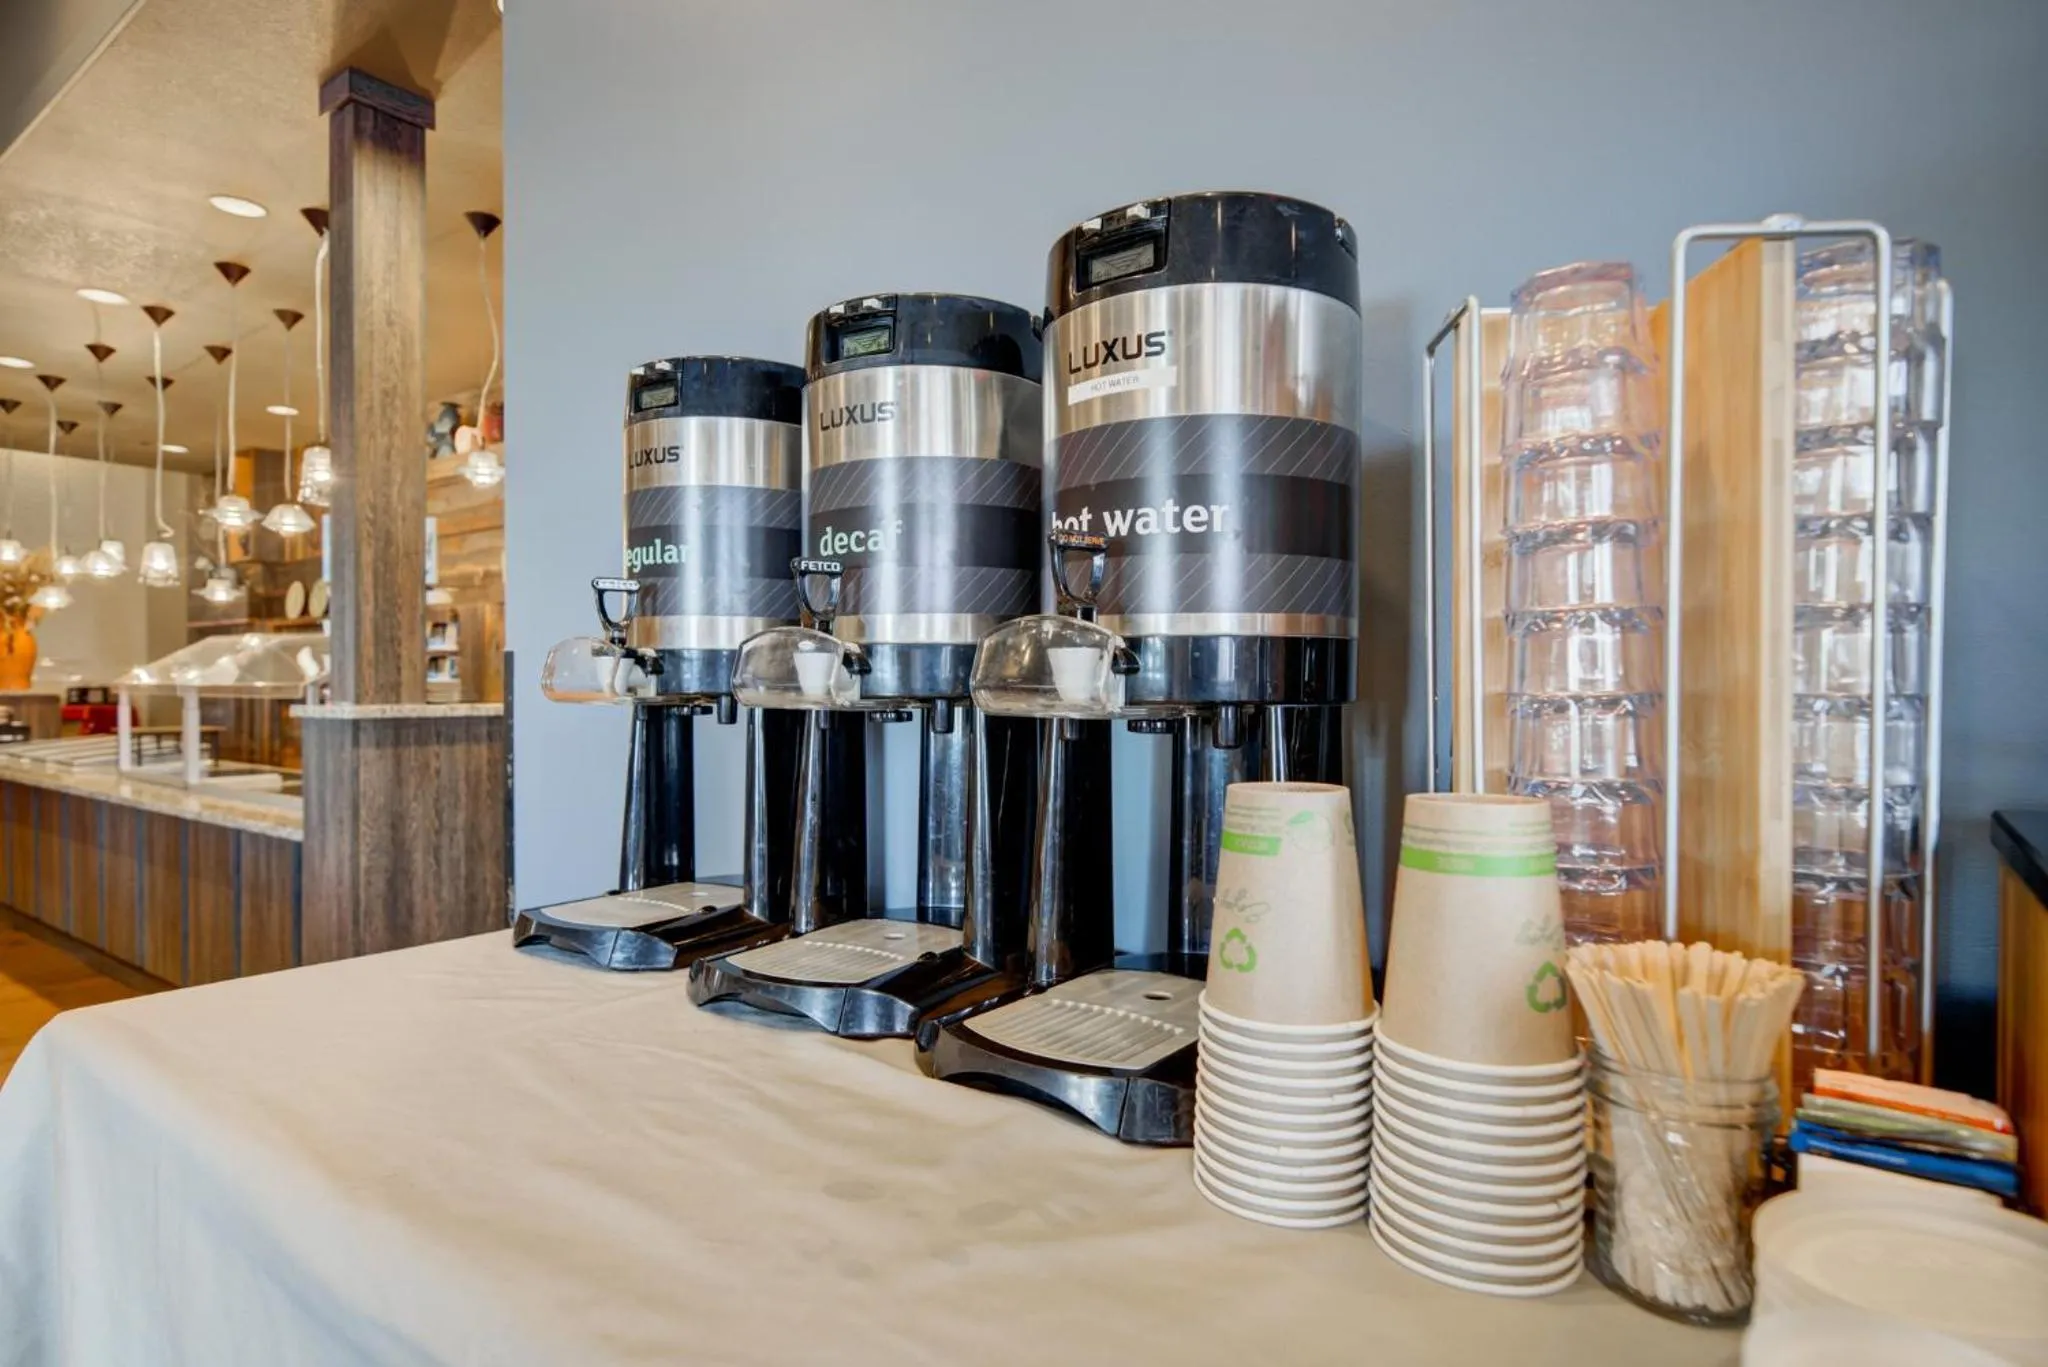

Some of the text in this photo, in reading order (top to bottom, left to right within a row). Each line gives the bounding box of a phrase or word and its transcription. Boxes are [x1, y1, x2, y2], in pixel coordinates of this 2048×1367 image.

[1068, 331, 1166, 374] LUXUS
[1090, 373, 1139, 392] HOT WATER
[820, 402, 896, 432] LUXUS
[1052, 497, 1230, 537] hot water
[819, 519, 904, 557] decaf
[800, 560, 841, 572] FETCO
